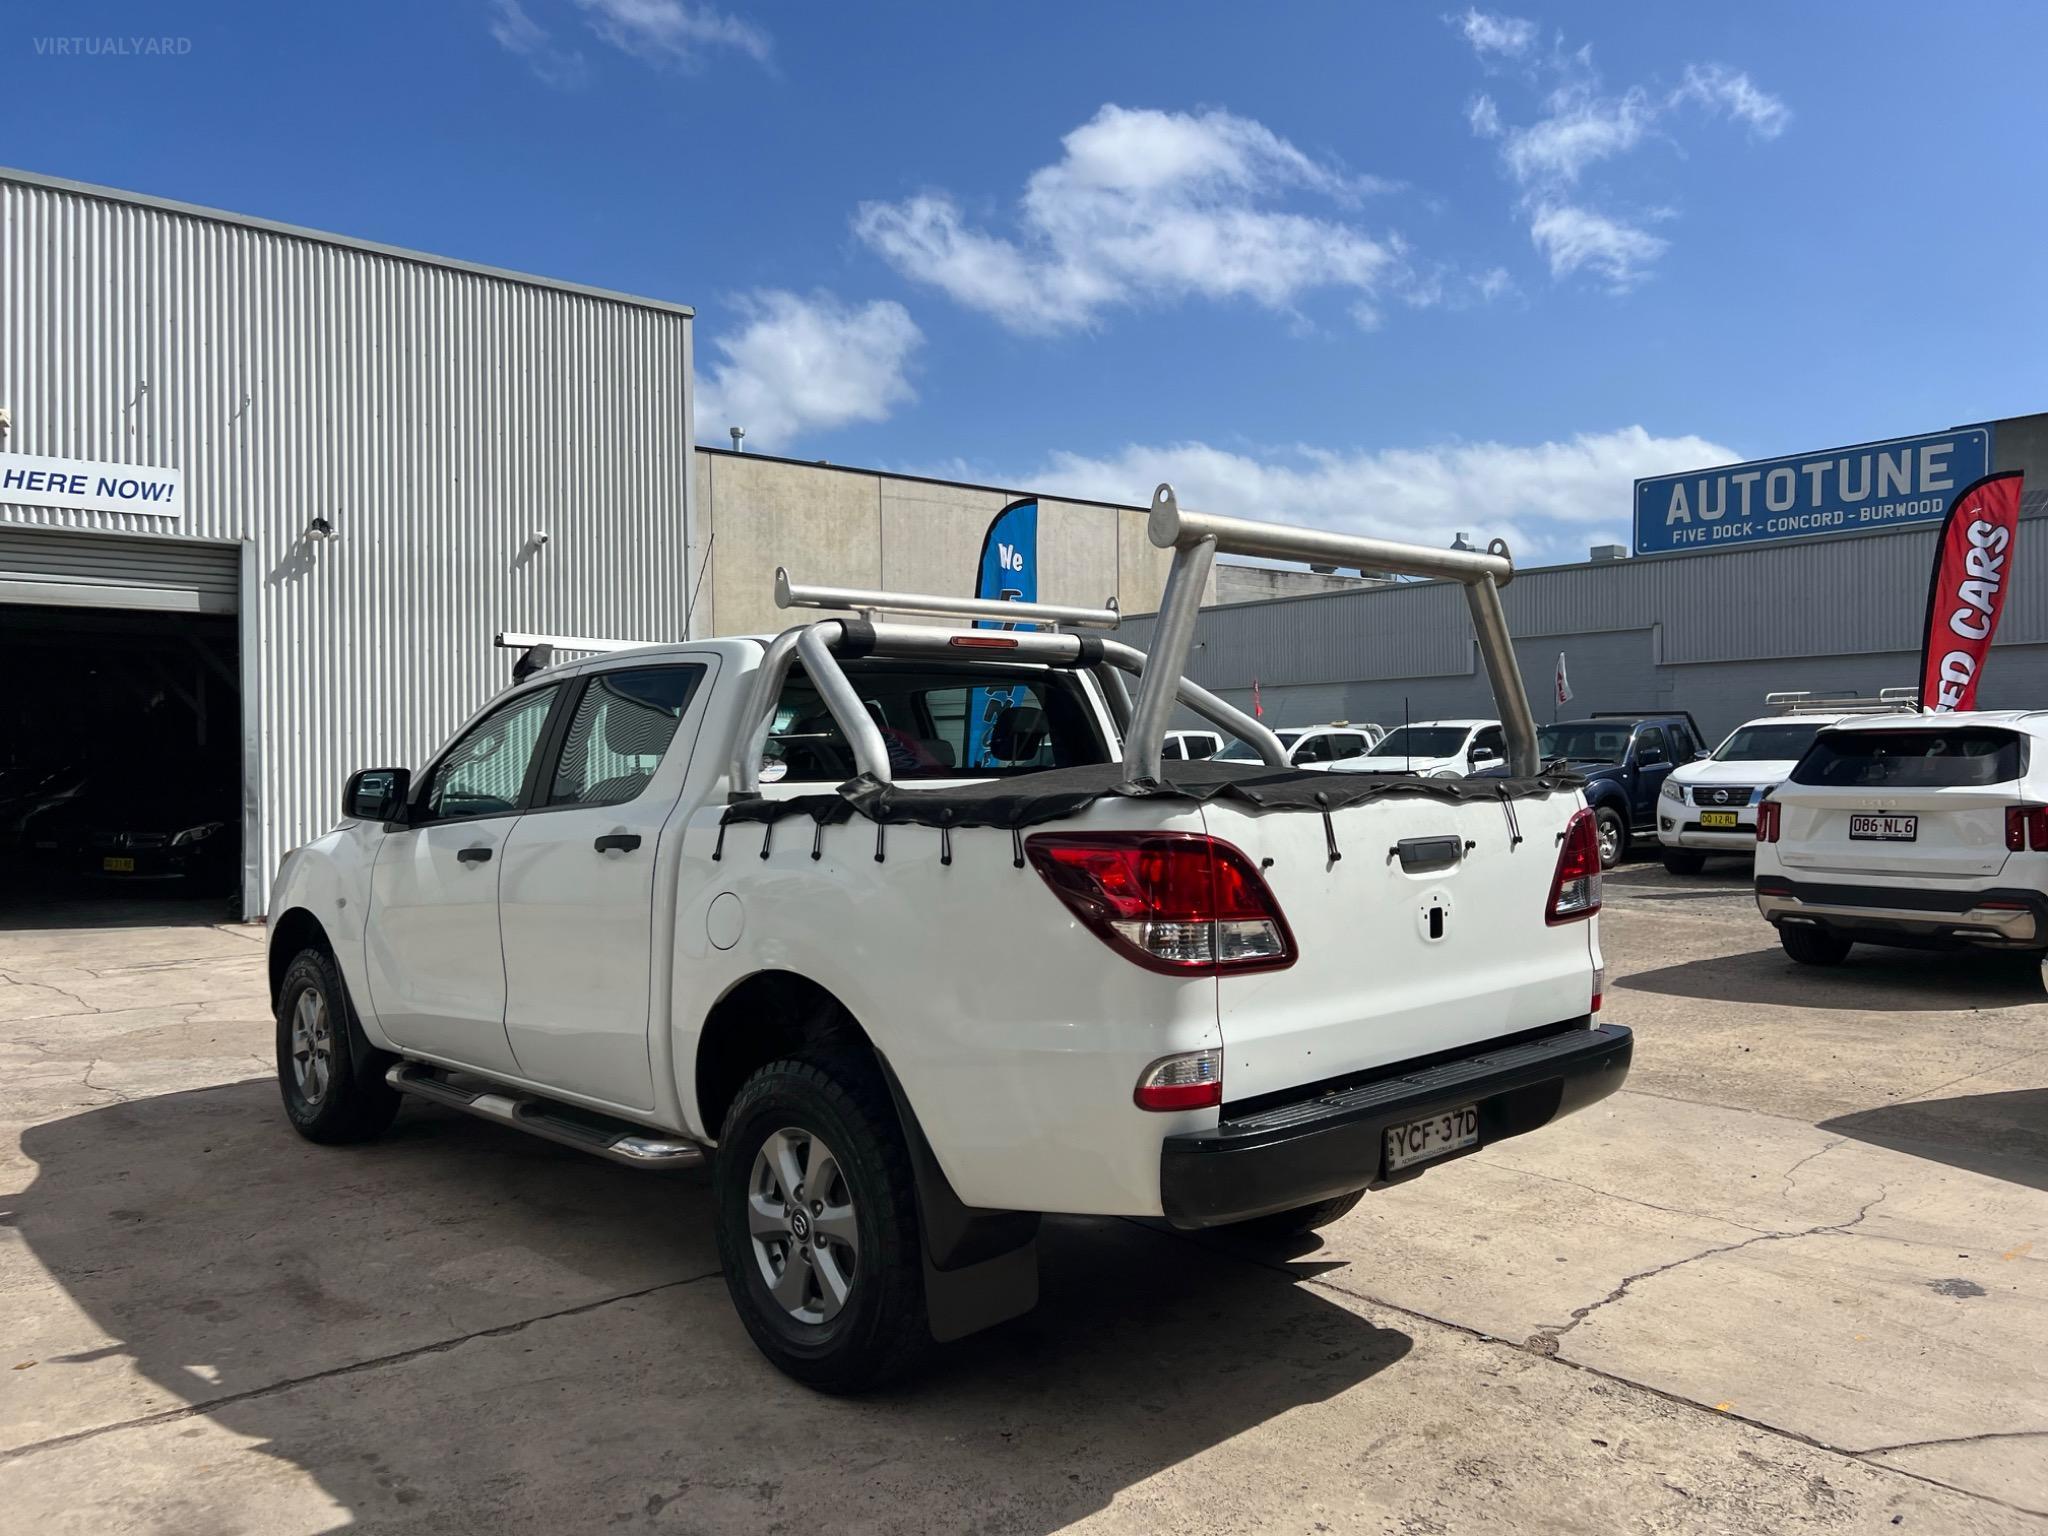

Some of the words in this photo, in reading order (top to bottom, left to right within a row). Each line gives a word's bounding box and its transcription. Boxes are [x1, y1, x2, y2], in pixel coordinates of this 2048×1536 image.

[3, 468, 88, 495] HERE
[96, 477, 175, 502] NOW!
[1666, 442, 1954, 525] AUTOTUNE
[1672, 528, 1706, 544] FIVE
[1713, 522, 1753, 539] DOCK
[1767, 511, 1844, 533] CONCORD
[1859, 498, 1943, 521] BURWOOD
[998, 543, 1023, 572] We
[1949, 518, 2010, 641] CARS
